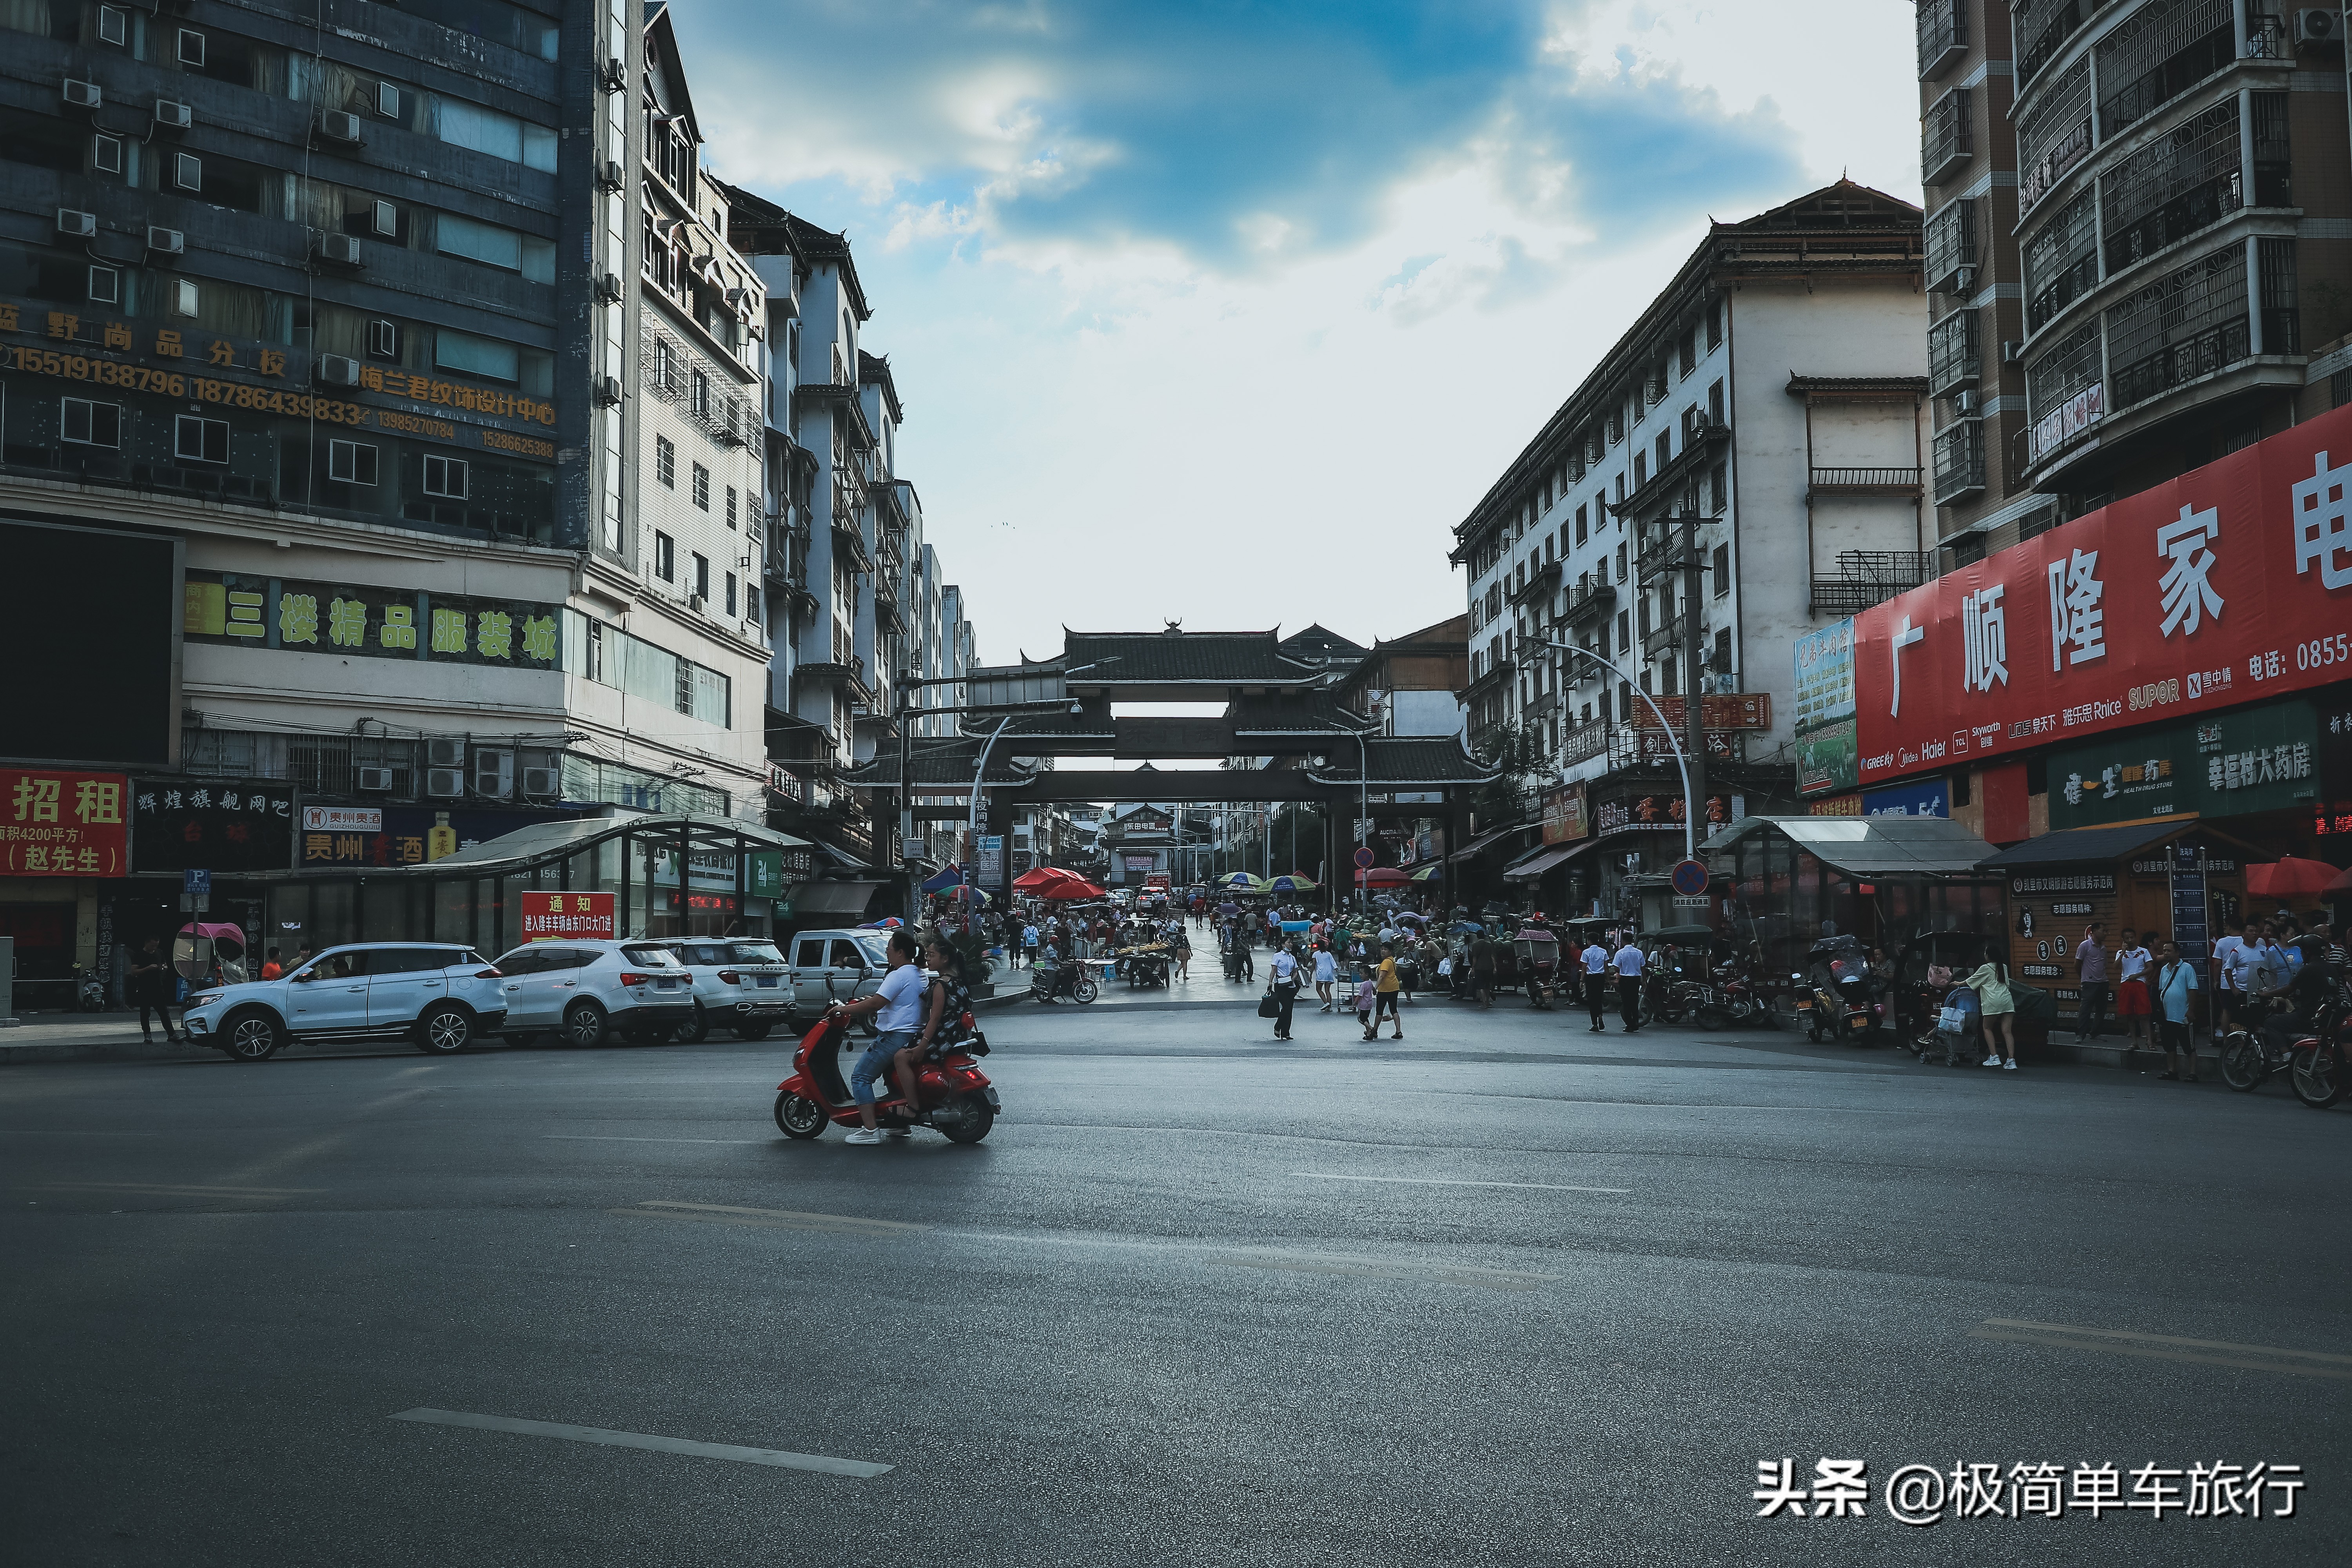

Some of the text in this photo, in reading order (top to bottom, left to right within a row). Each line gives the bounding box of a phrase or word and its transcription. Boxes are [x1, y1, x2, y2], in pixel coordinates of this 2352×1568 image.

[13, 347, 360, 425] 15519138796 18786439833
[359, 365, 556, 425] 梅兰君纹饰设计中心
[378, 411, 553, 458] 13985270784 15286625388
[1891, 450, 2352, 718] 广顺隆家电
[227, 591, 557, 660] 三楼精品服装城
[2298, 633, 2352, 671] 0855
[2203, 667, 2232, 688] 雪中情
[2129, 678, 2179, 711] SUPOR
[2204, 683, 2232, 694] XUEZHONGQING
[2033, 714, 2056, 734] 泉天下
[2063, 699, 2122, 728] 雅乐思 Rnice
[1972, 722, 2000, 737] Skyworth
[1644, 734, 1728, 753] 剑心浴
[1922, 739, 1945, 760] Haier
[1955, 738, 1966, 747] TCL
[1981, 735, 1993, 748] 创维
[2122, 759, 2173, 783] 健康药房
[2209, 742, 2311, 790] 幸福村大药房
[2124, 781, 2173, 794] HEALTH DRUG STORE
[12, 777, 122, 824] 招租
[137, 789, 290, 817] 辉煌旗舰网吧
[2153, 804, 2173, 815] 文化北路店
[330, 812, 381, 824] 贵州贵酒
[193, 871, 204, 882] P
[2024, 875, 2113, 891] 凯里市文明旅游志愿服务示范岗
[549, 896, 591, 912] 通知
[525, 915, 612, 932] 进入隆丰车辆由东门口大门进
